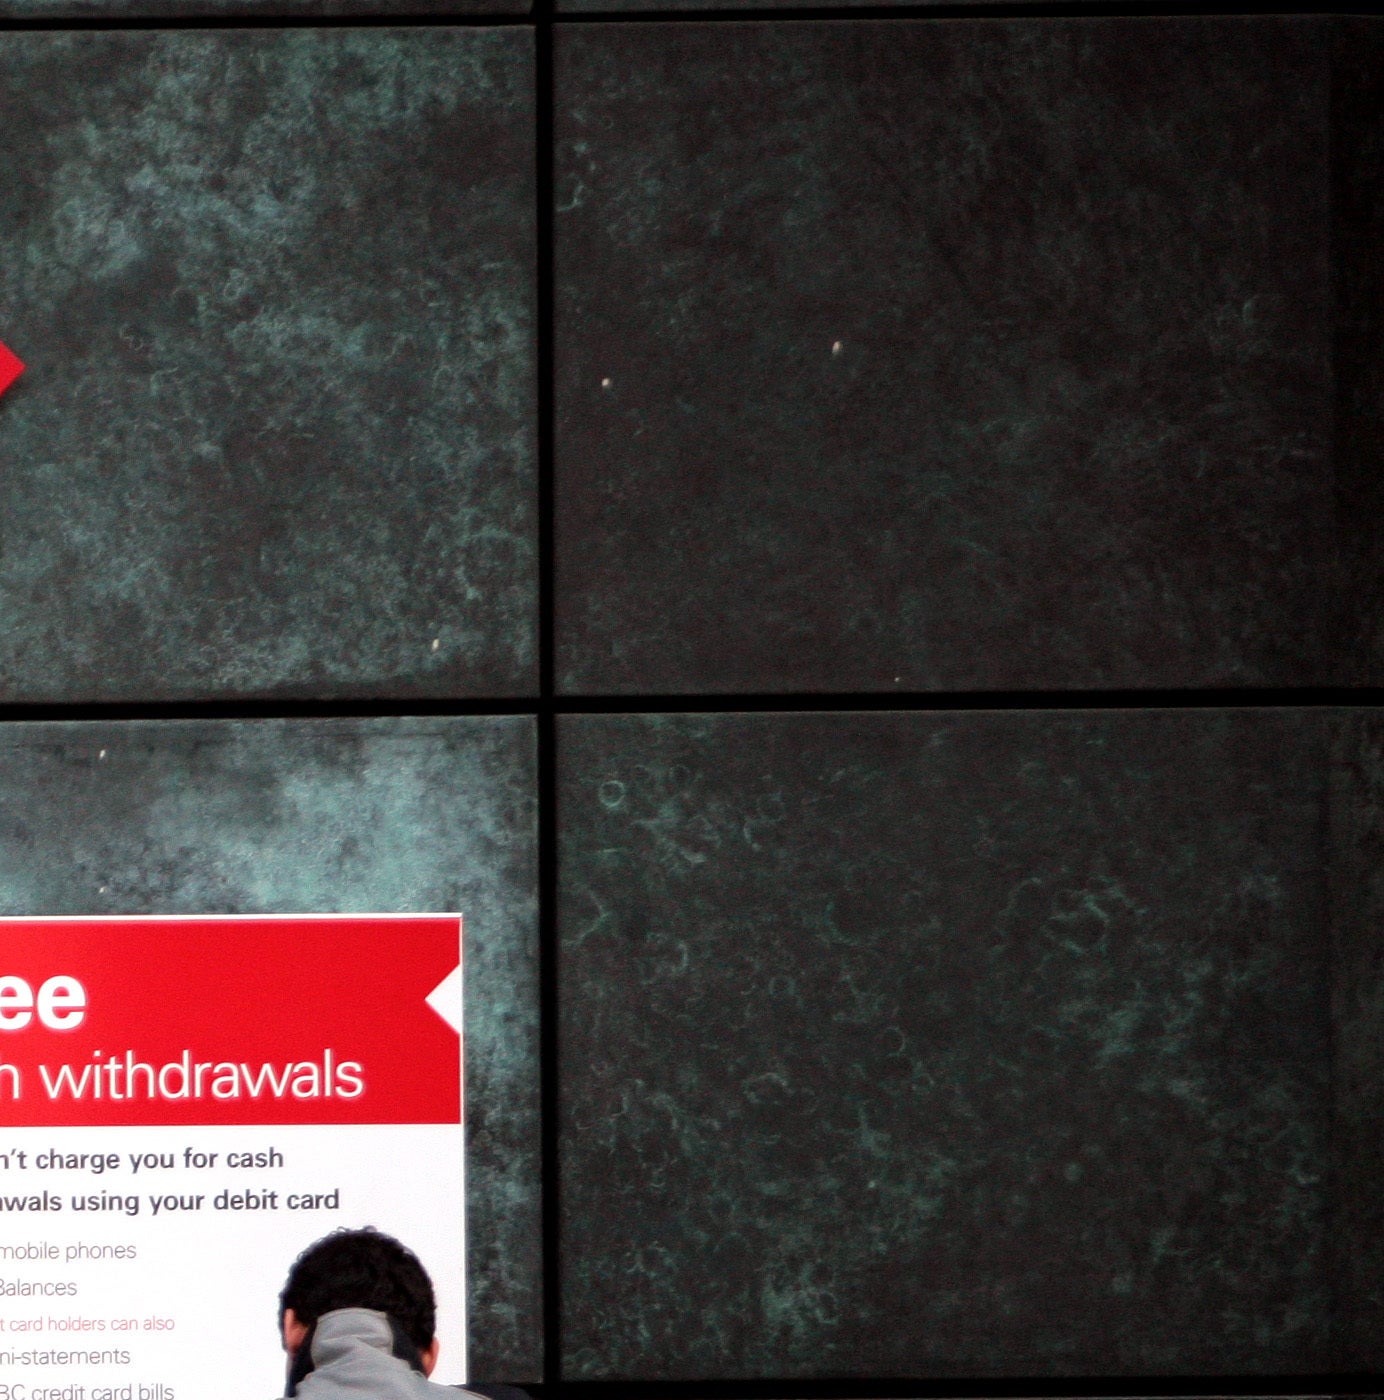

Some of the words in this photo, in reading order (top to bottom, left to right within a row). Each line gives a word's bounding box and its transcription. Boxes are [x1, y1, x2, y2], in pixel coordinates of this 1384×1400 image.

[39, 1049, 363, 1099] withdrawals
[35, 1148, 121, 1175] charge
[129, 1153, 175, 1174] you
[183, 1146, 219, 1169] for
[226, 1146, 284, 1169] cash
[71, 1189, 140, 1217] using
[149, 1195, 205, 1216] your
[213, 1188, 279, 1211] debit
[286, 1188, 340, 1210] card
[65, 1241, 137, 1263] phones
[9, 1316, 44, 1332] card
[47, 1316, 106, 1332] holders
[110, 1318, 139, 1331] can
[142, 1315, 176, 1331] also
